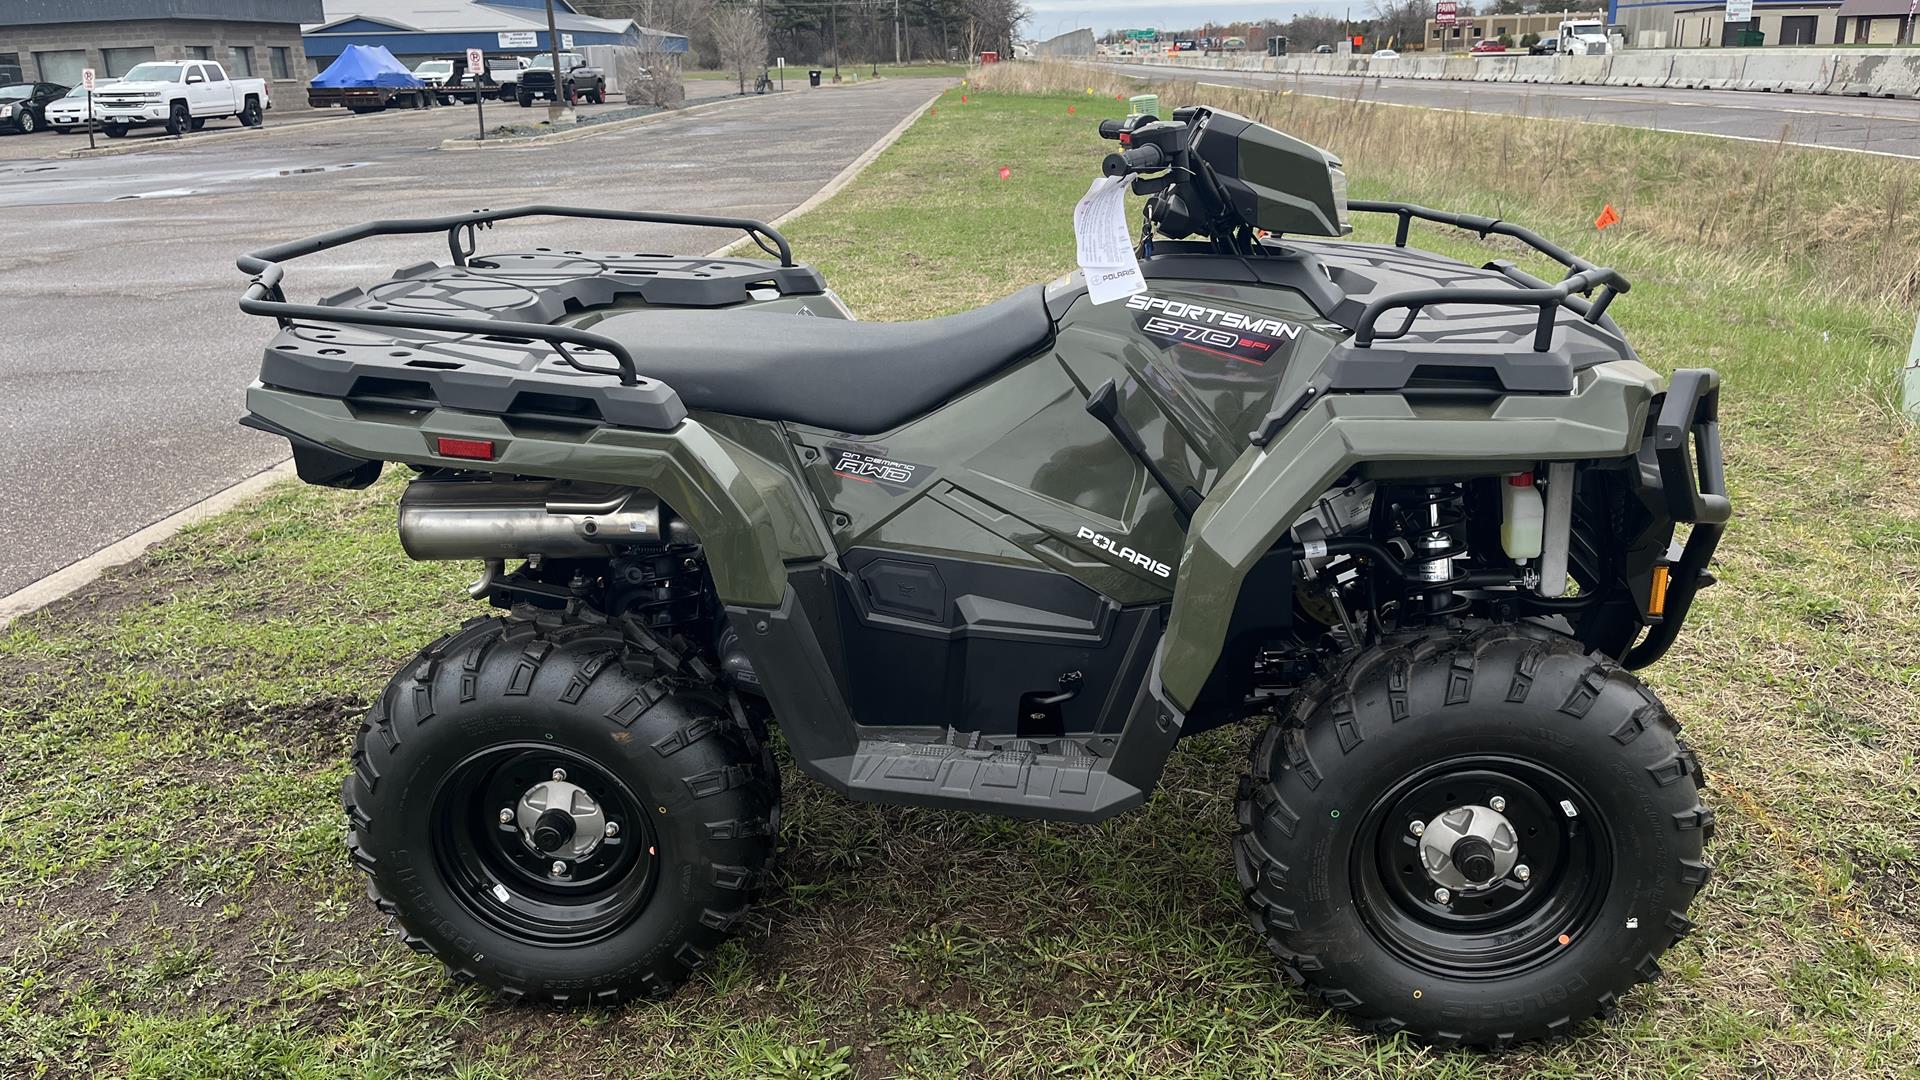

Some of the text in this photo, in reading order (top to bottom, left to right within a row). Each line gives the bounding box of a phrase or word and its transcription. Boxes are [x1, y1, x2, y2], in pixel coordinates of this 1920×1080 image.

[1437, 3, 1456, 12] PAWN
[1102, 268, 1136, 281] POLARIS
[1125, 295, 1302, 340] SPORTSMAN
[1143, 317, 1271, 351] 570 EFI
[835, 458, 912, 483] AWD
[842, 451, 916, 471] ON DEMAND
[1076, 525, 1172, 579] POLARIS
